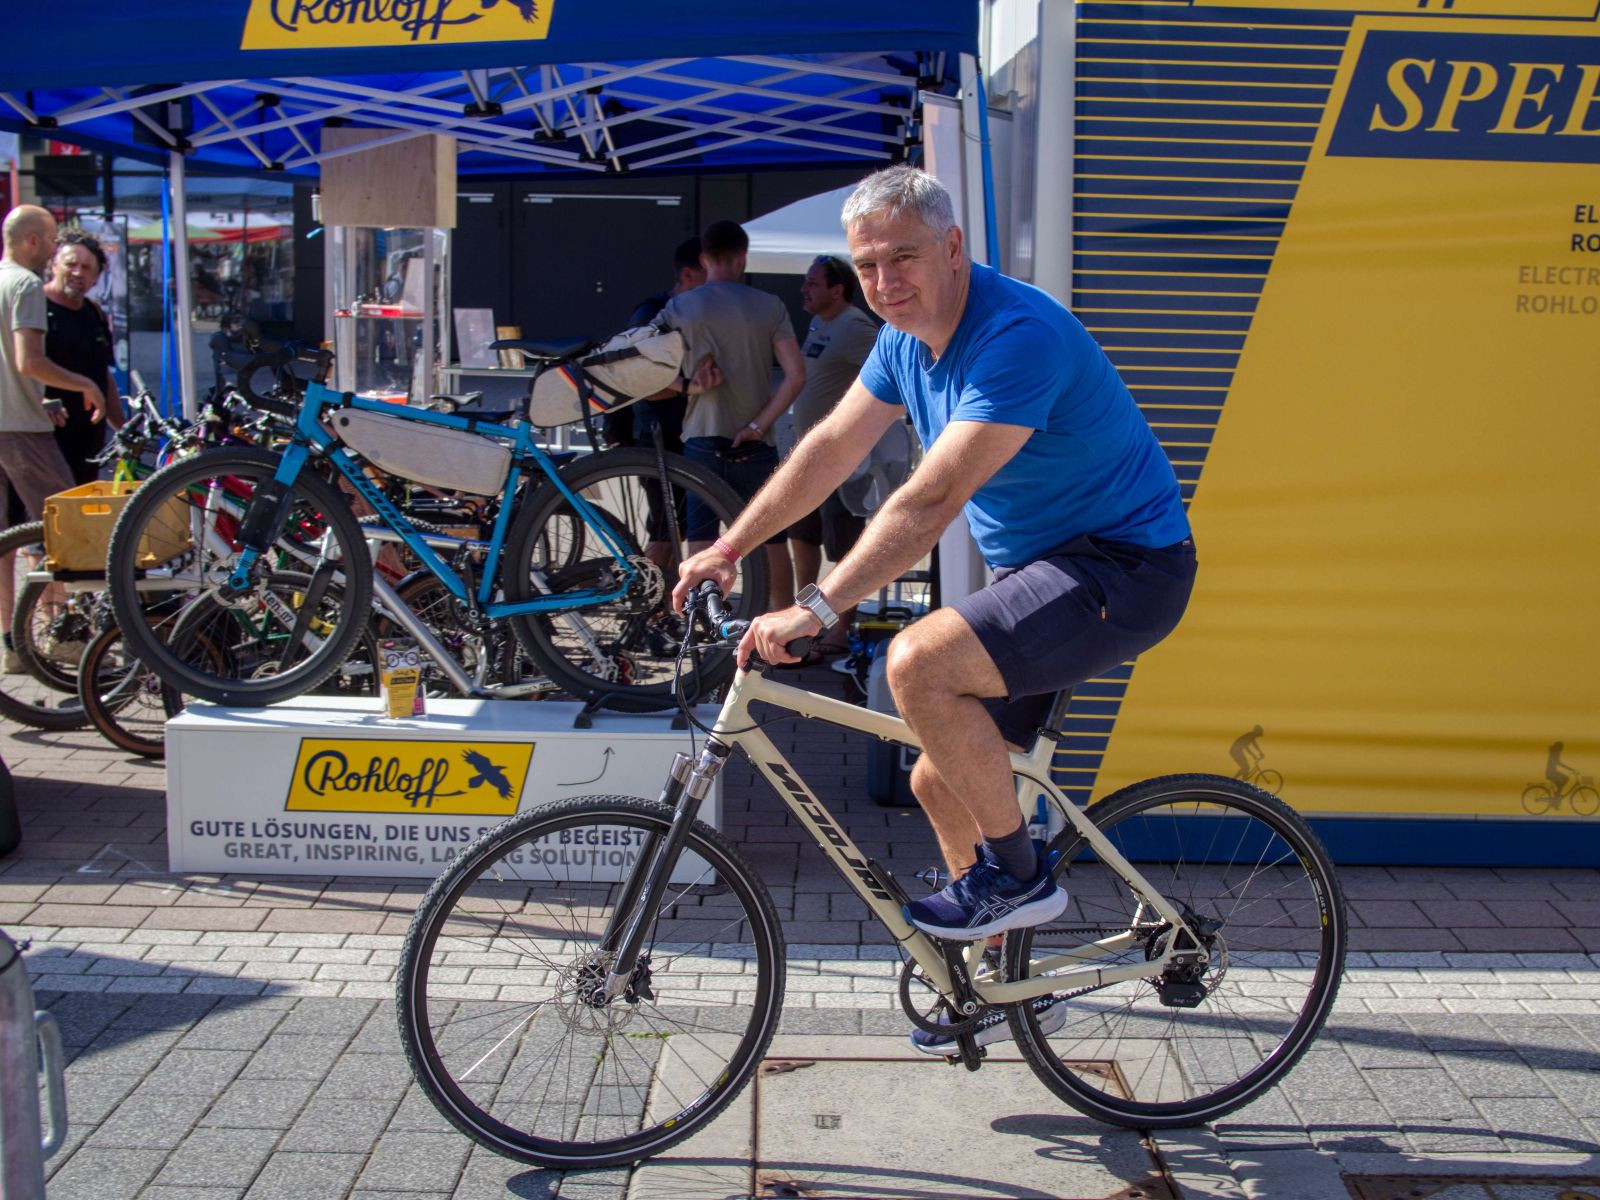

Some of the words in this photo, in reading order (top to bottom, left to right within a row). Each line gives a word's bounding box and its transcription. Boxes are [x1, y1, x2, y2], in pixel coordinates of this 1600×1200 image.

[1518, 264, 1600, 286] ELECTR
[1515, 294, 1598, 315] ROHLO
[304, 750, 468, 808] Rohloff
[190, 820, 245, 838] GUTE
[251, 818, 378, 843] LÖSUNGEN,
[385, 824, 418, 841] DIE
[425, 825, 470, 842] UNS
[559, 828, 645, 846] BEGEIST
[766, 762, 893, 901] NICOLAI
[224, 841, 298, 863] GREAT,
[306, 843, 425, 865] INSPIRING,
[530, 848, 638, 867] SOLUTION
